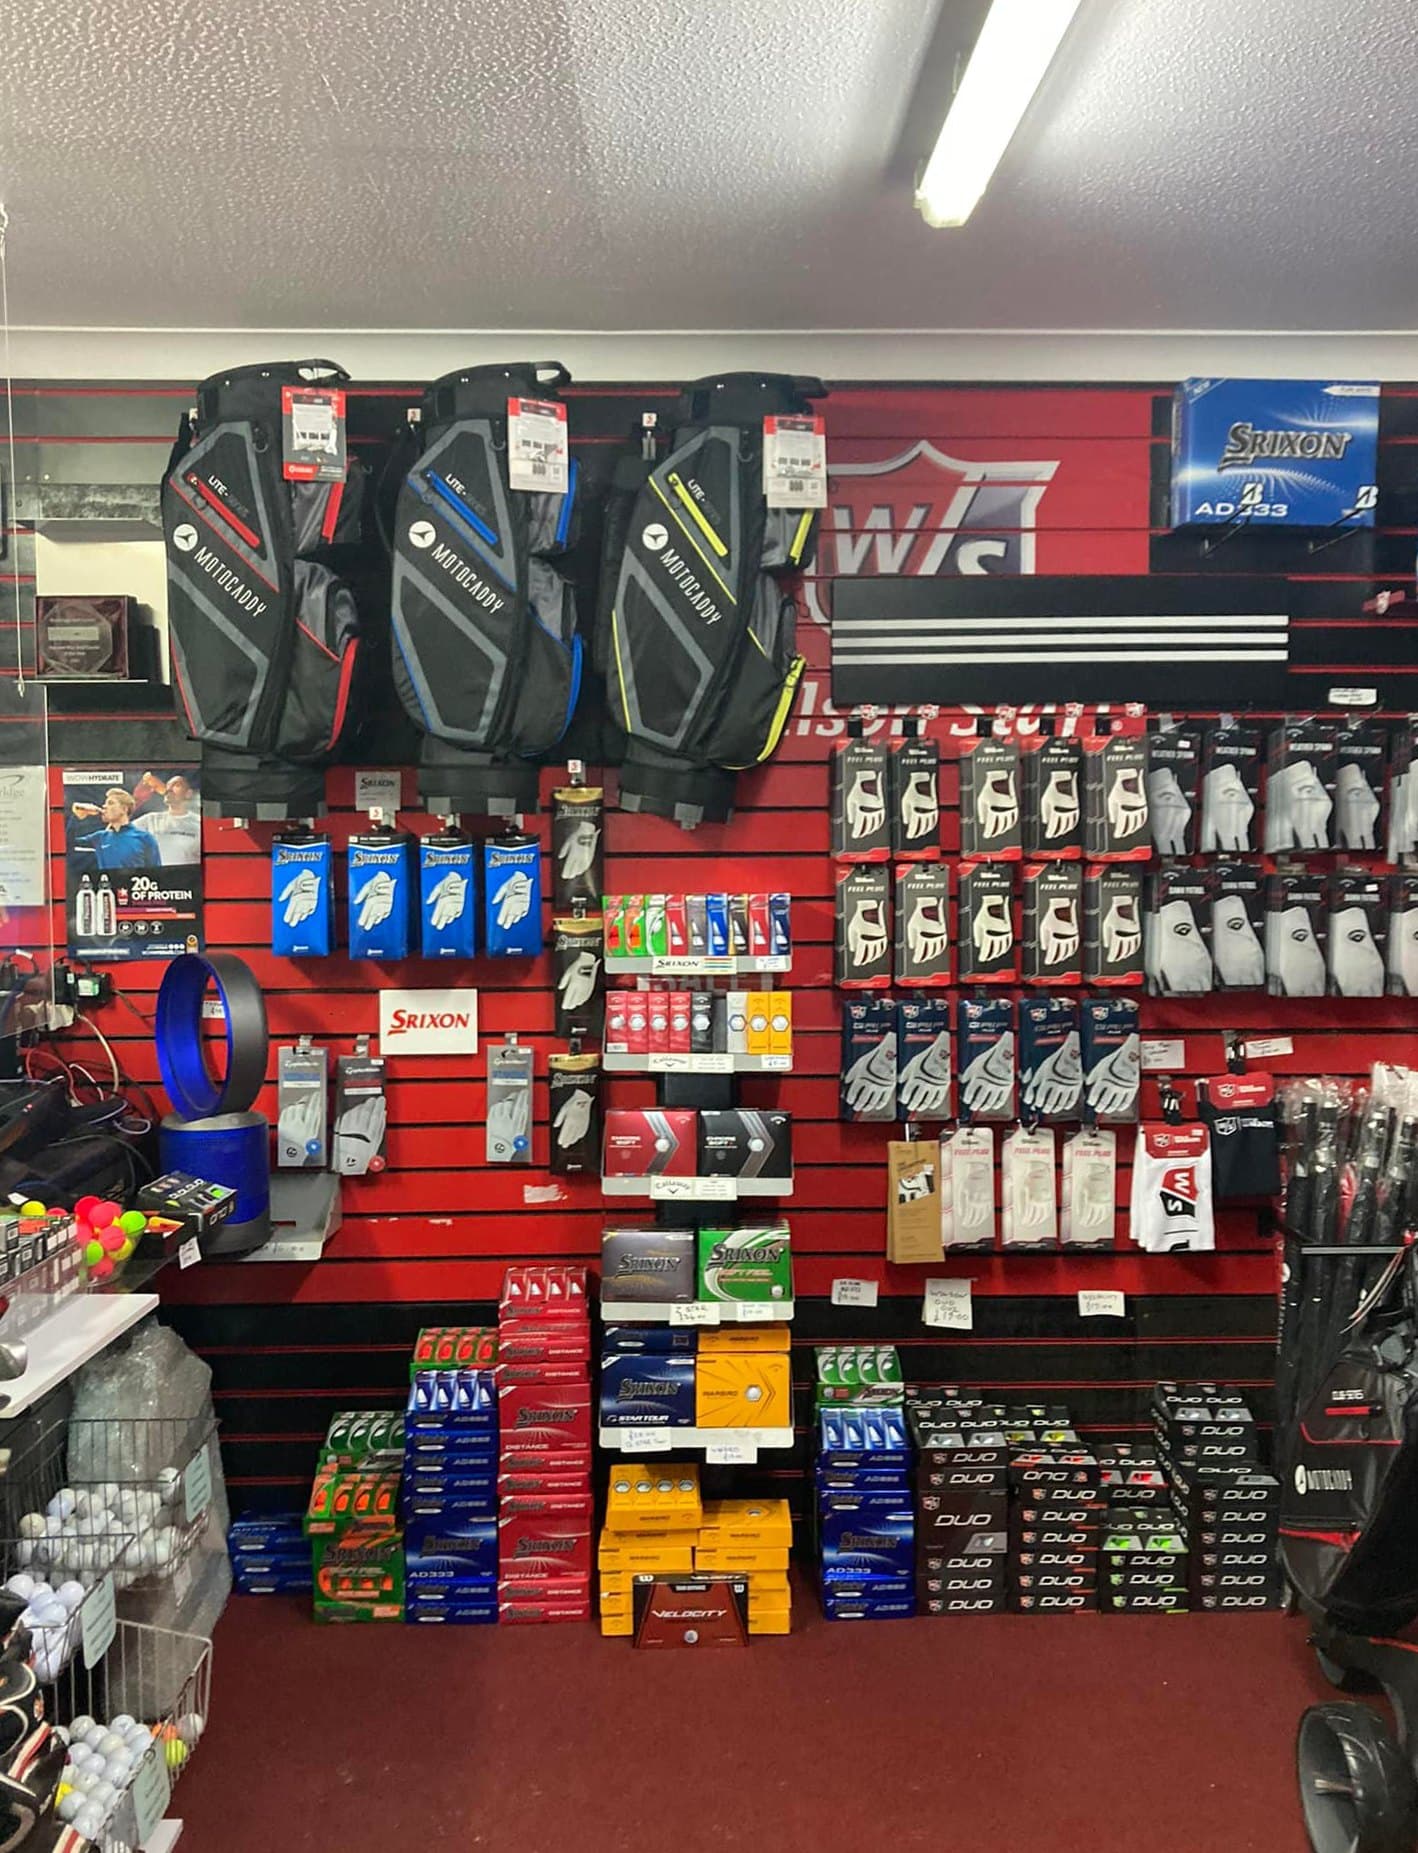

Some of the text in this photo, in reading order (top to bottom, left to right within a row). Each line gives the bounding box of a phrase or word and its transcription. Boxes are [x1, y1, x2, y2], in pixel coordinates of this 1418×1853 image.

[1217, 421, 1352, 473] SRIXON
[194, 547, 268, 618] MOTOCADDY
[431, 543, 505, 614] MOTOCADDY
[660, 548, 722, 625] MOTOCADDY
[131, 877, 158, 890] 20G
[132, 890, 192, 900] OF PROTEIN
[656, 960, 699, 969] SRIXON
[388, 1009, 470, 1035] SRIXON
[705, 1243, 784, 1271] SRIXON
[615, 1253, 680, 1277] SRIXON
[617, 1378, 681, 1401] SRIXON
[514, 1408, 577, 1428] SRIXON
[919, 1420, 998, 1429] DUO DUO
[1200, 1426, 1244, 1436] DUO
[1202, 1446, 1246, 1455] DUO
[952, 1453, 998, 1463] DUO
[1119, 1458, 1156, 1466] DUO
[950, 1474, 995, 1483] DUO
[1051, 1489, 1096, 1499] DUO
[1112, 1489, 1156, 1498] DUO
[1223, 1490, 1268, 1500] DUO
[934, 1514, 992, 1526] DUO
[1042, 1511, 1087, 1521] DUO
[1221, 1512, 1267, 1522] DUO
[1041, 1532, 1087, 1543] DUO
[1221, 1533, 1266, 1543] DUO
[513, 1536, 577, 1559] SRIXON
[947, 1558, 992, 1568] DUO
[1040, 1554, 1085, 1564] DUO
[1130, 1555, 1176, 1565] DUO
[1222, 1555, 1267, 1564] DUO
[1039, 1576, 1084, 1586] DUO
[1129, 1574, 1175, 1584] DUO
[1220, 1575, 1265, 1585] DUO
[947, 1579, 992, 1590] DUO
[948, 1600, 993, 1610] DUO
[1039, 1596, 1085, 1606] DUO
[1132, 1596, 1177, 1606] DUO
[1221, 1597, 1267, 1606] DUO
[651, 1609, 727, 1618] VELOCITY
